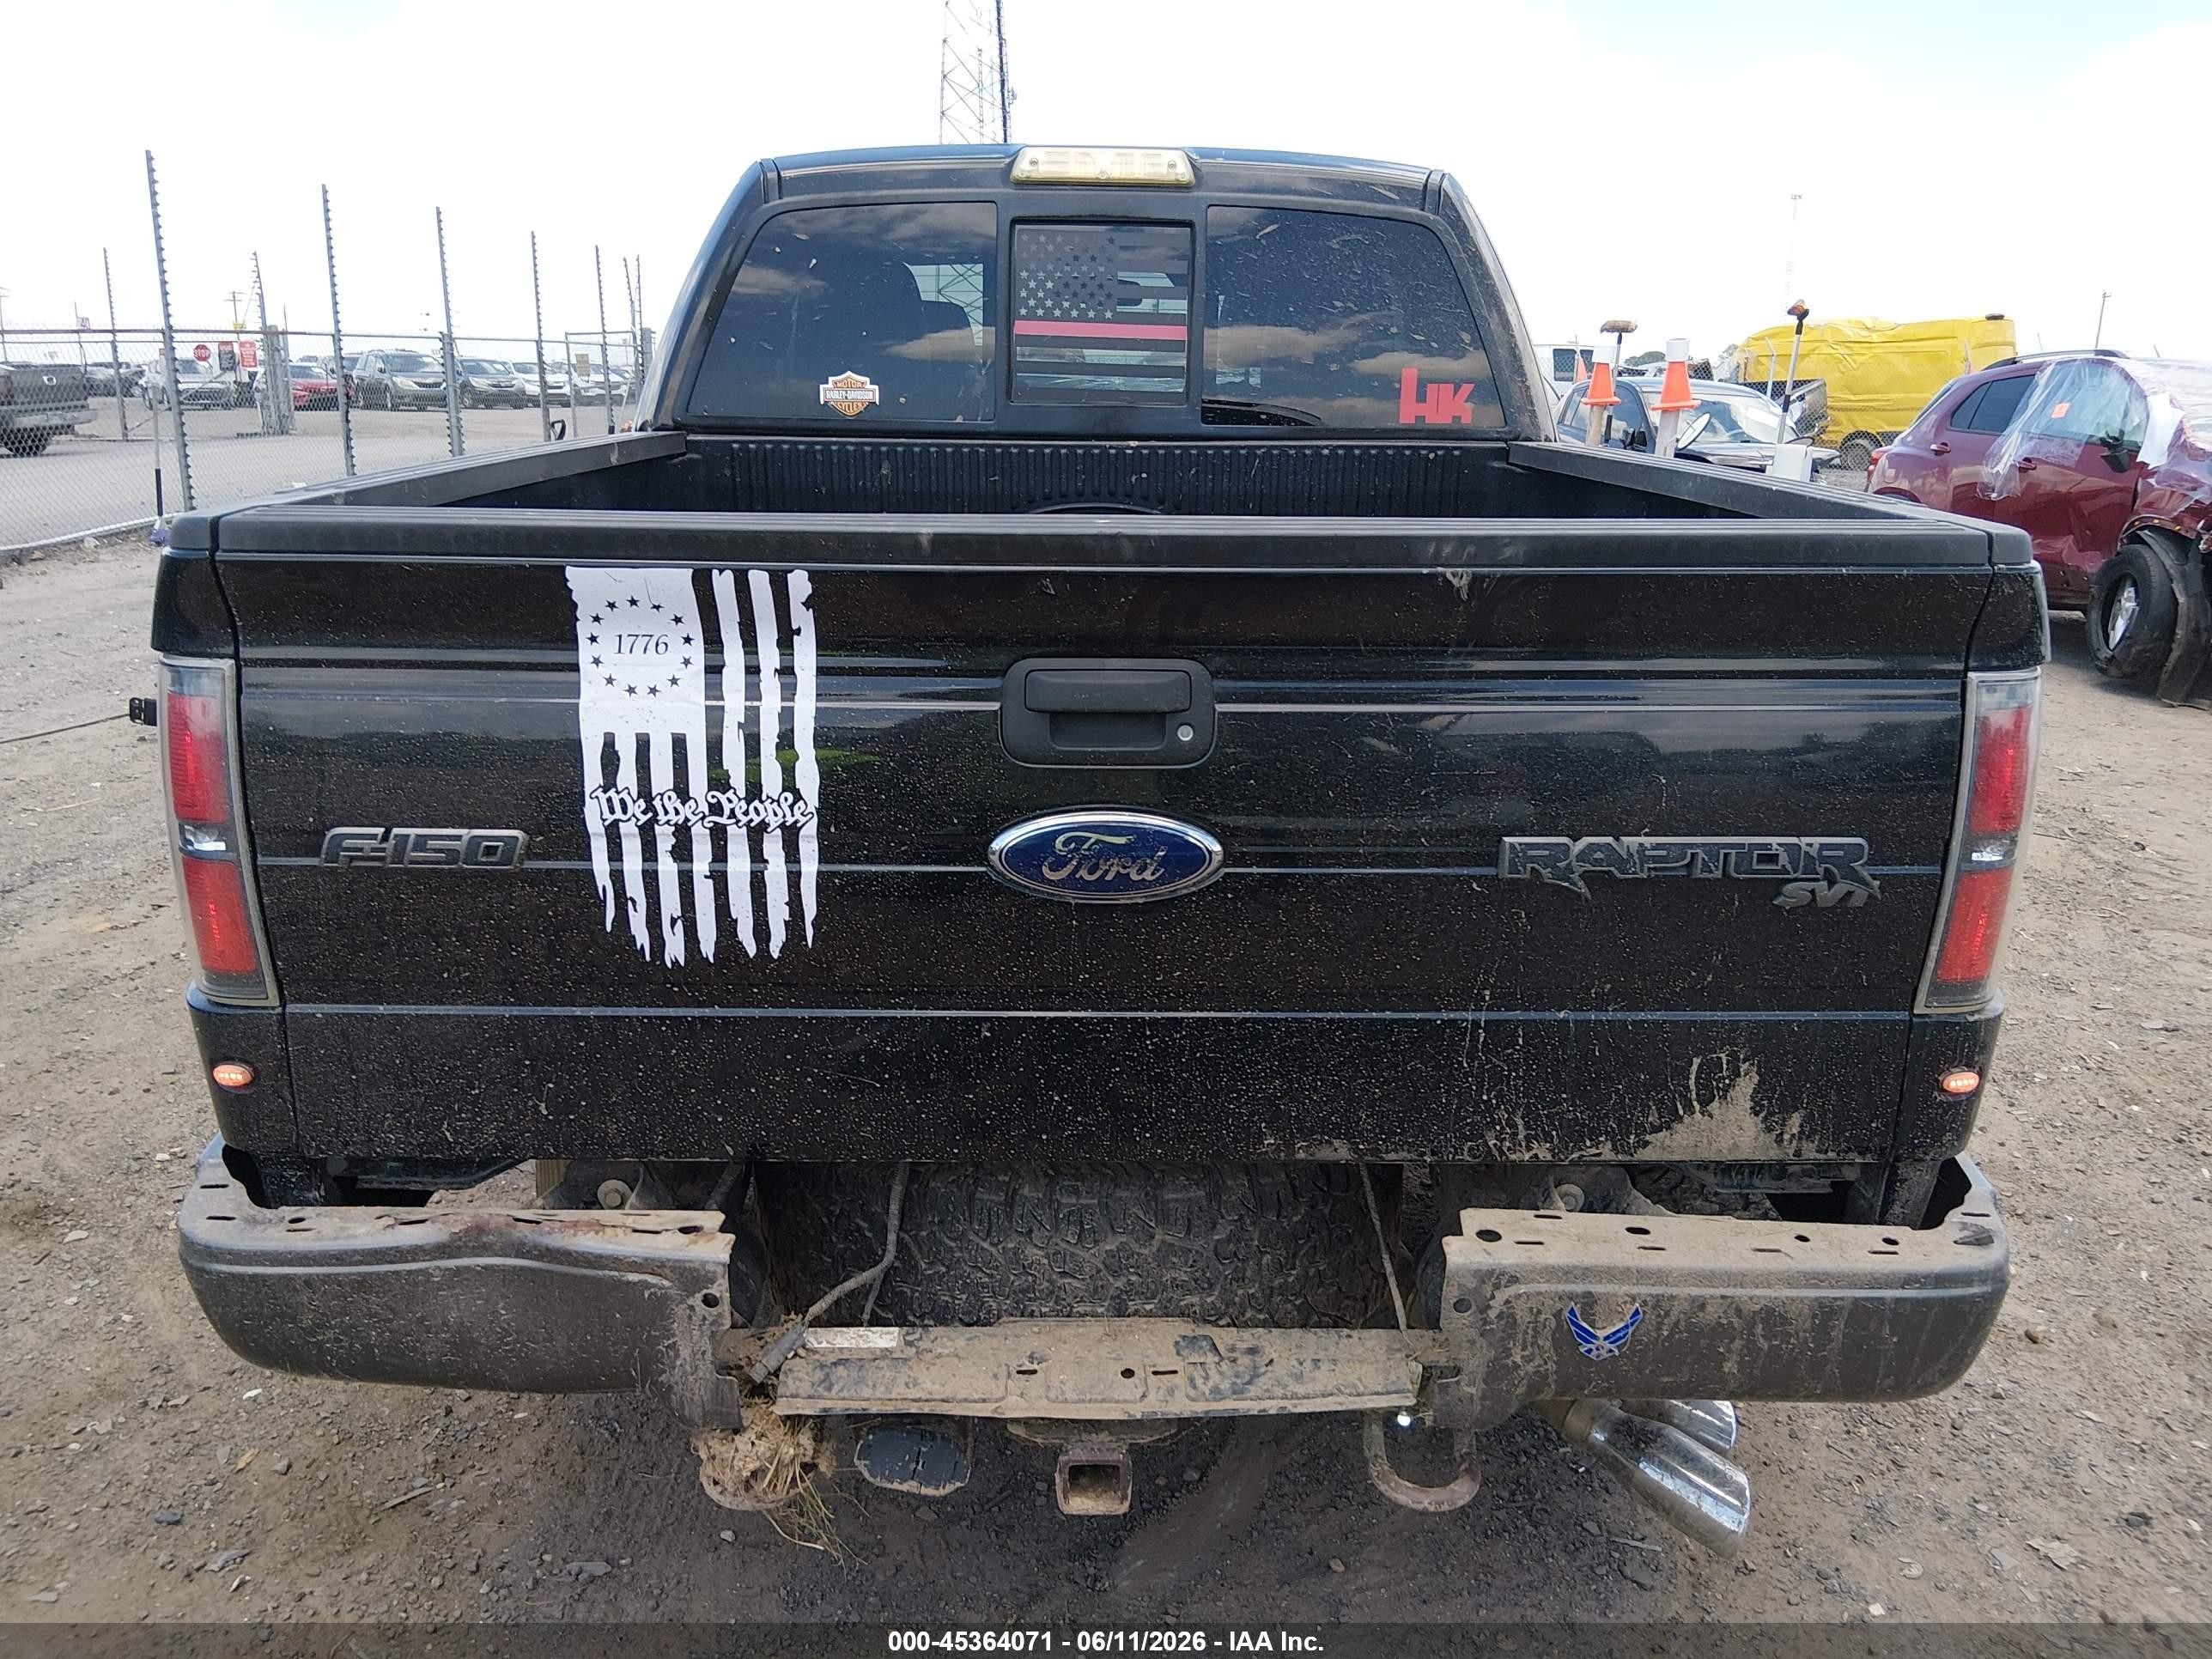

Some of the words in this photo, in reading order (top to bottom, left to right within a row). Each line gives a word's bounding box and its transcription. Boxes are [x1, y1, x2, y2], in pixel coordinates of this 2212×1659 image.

[194, 349, 210, 358] STOP
[837, 378, 863, 388] MOTOR
[826, 390, 873, 399] HARLEY-DAVIDSON
[613, 634, 669, 655] 1776
[590, 787, 653, 826] We
[651, 790, 706, 826] the
[700, 788, 815, 831] People
[1042, 831, 1167, 881] Ford
[1498, 836, 1881, 900] RAPTOR
